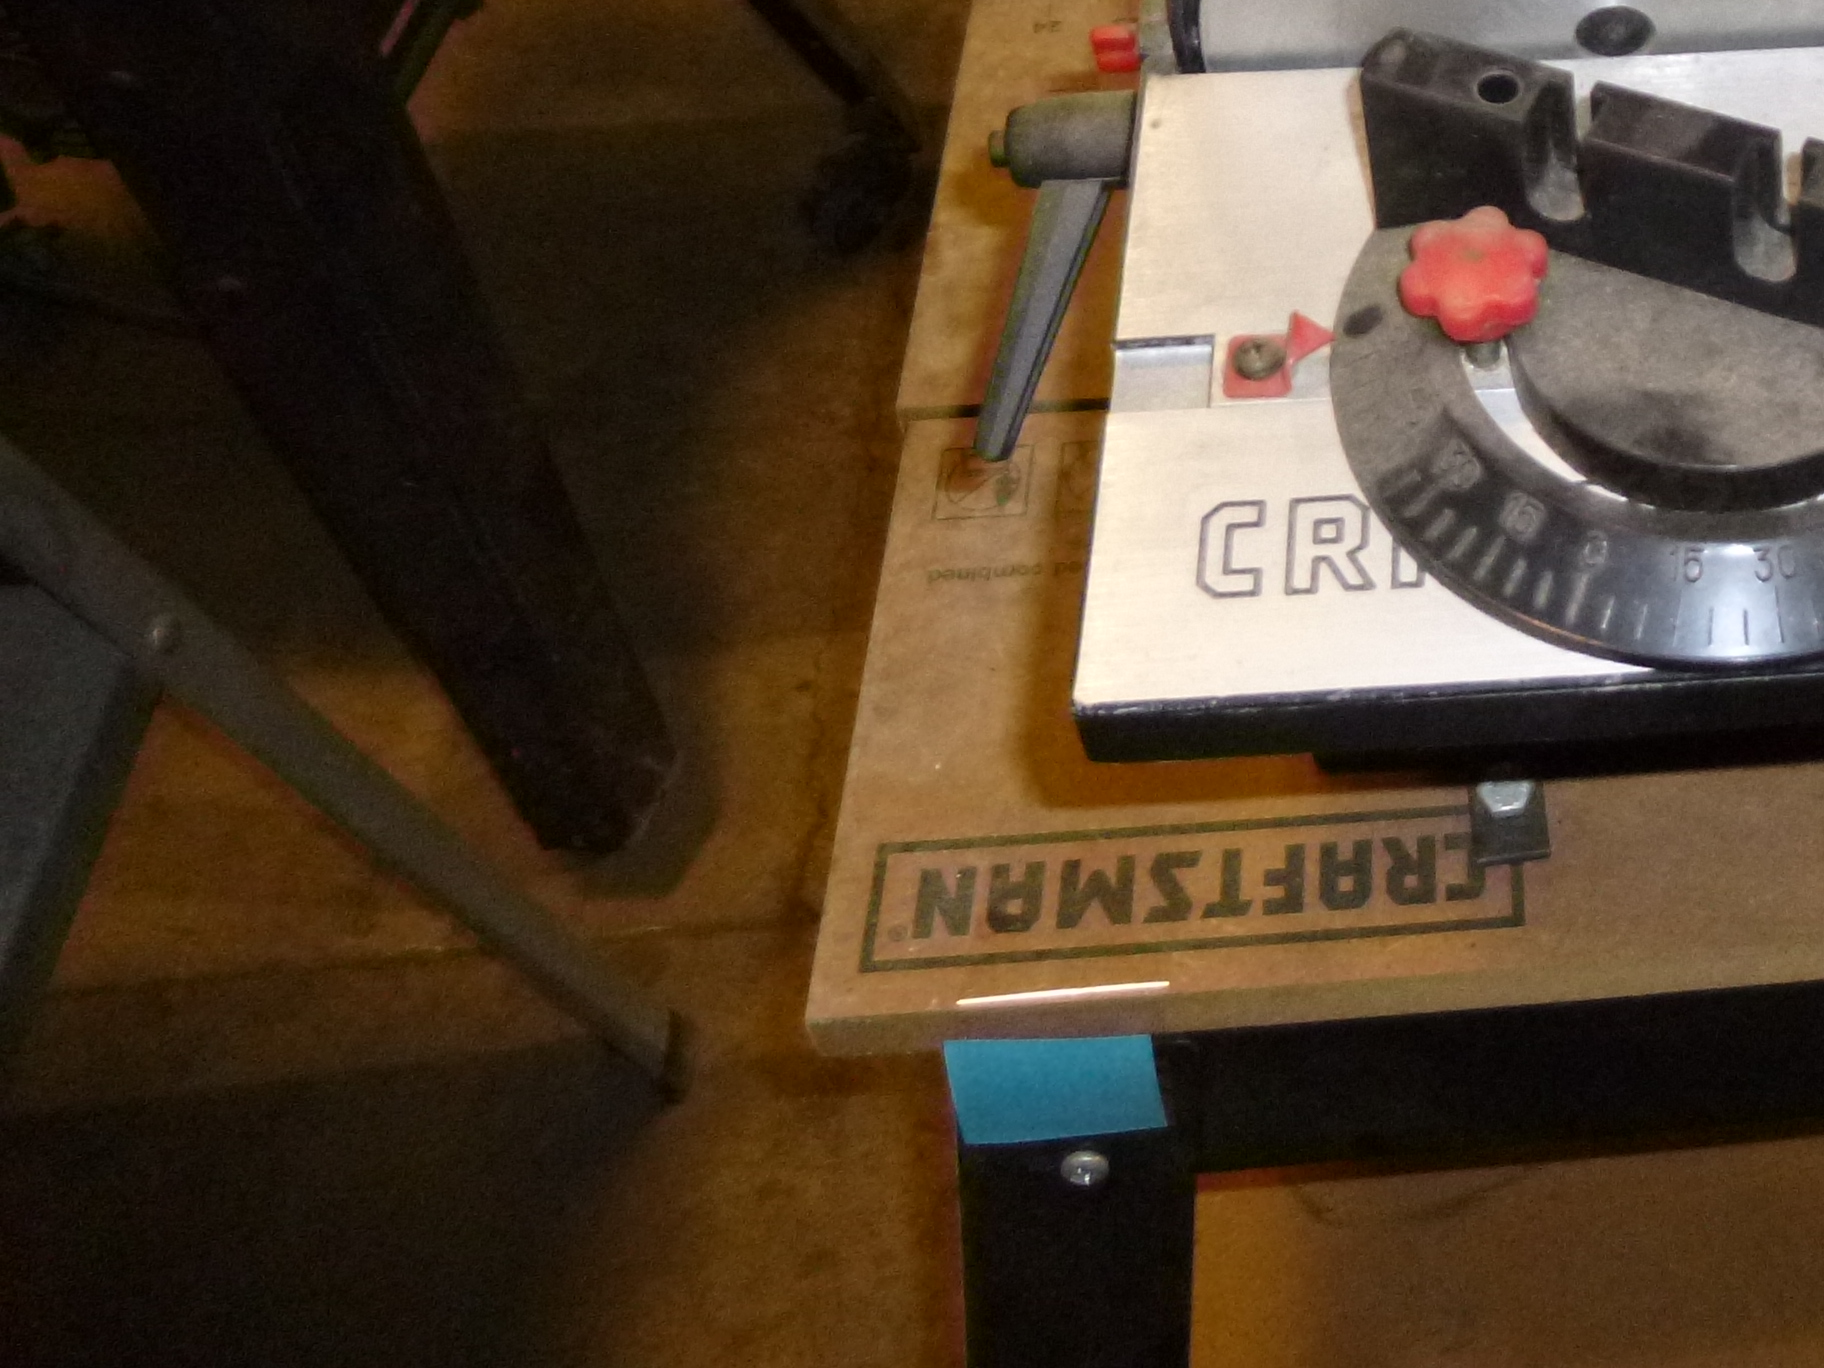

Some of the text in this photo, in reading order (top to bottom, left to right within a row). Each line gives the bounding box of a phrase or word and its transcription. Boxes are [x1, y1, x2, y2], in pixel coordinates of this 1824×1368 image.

[1498, 490, 1548, 541] 15
[1583, 528, 1609, 565] 0
[1668, 545, 1704, 583] 15
[1752, 543, 1797, 583] 30
